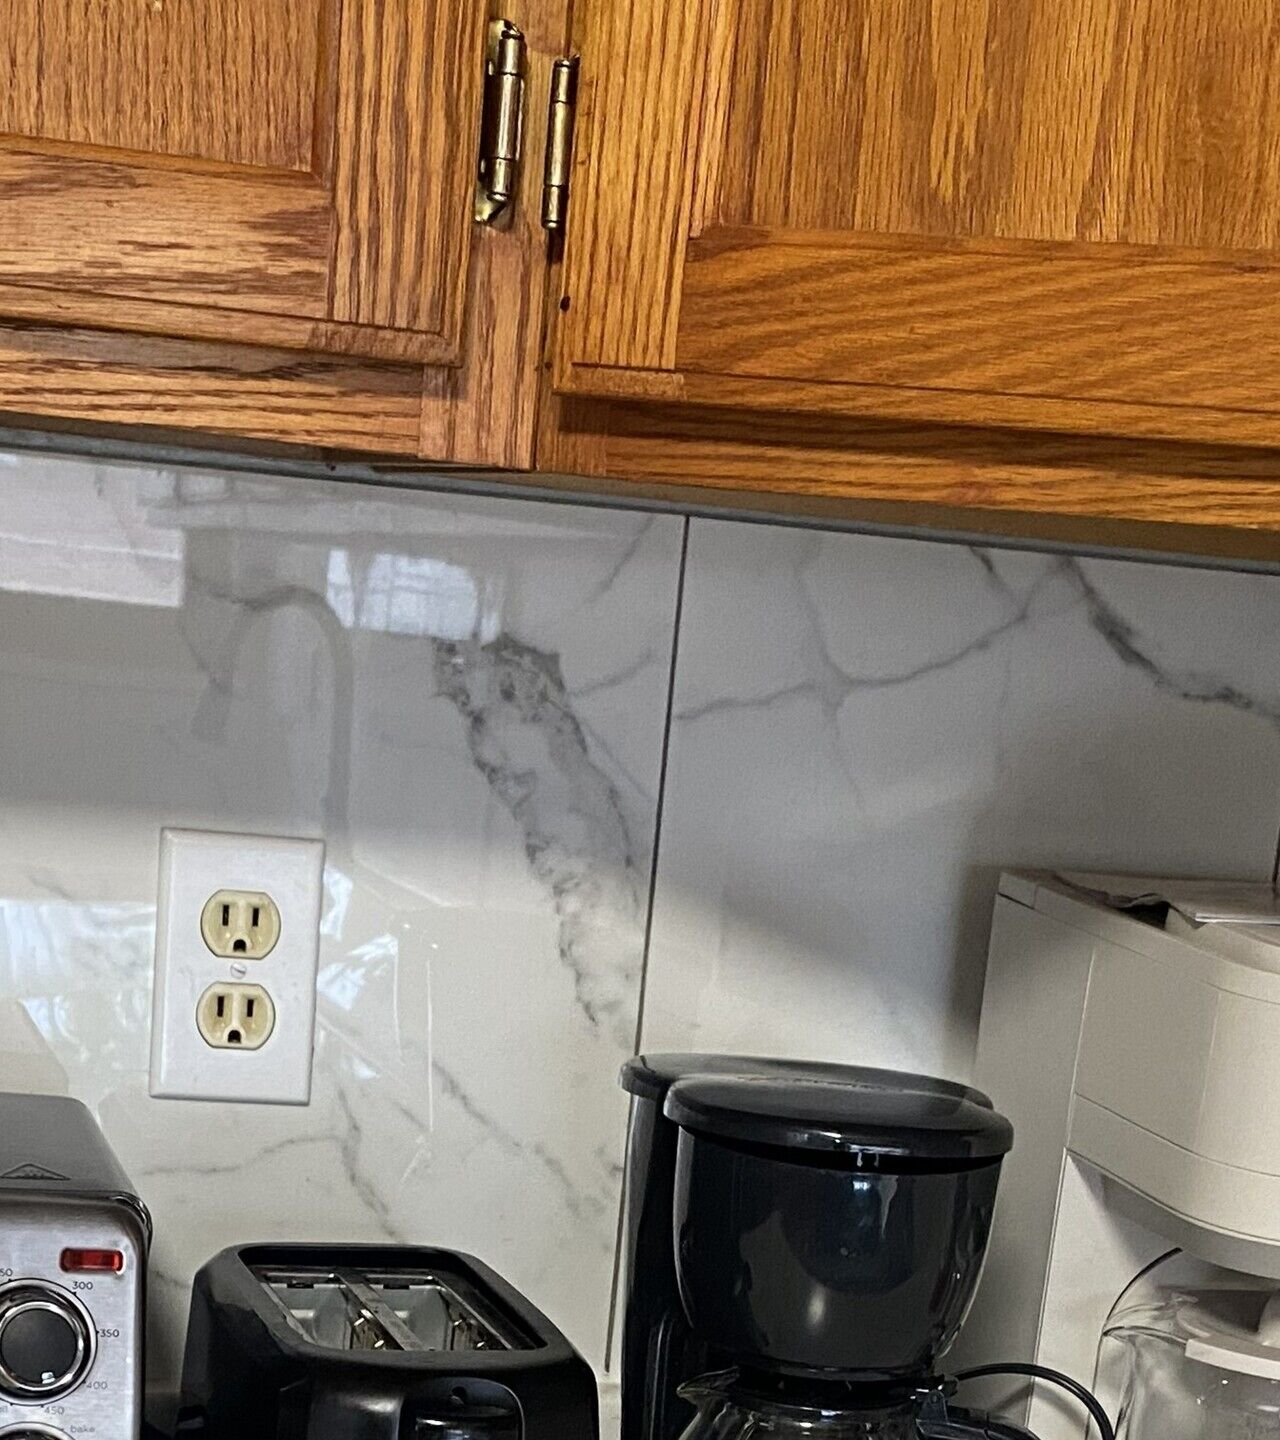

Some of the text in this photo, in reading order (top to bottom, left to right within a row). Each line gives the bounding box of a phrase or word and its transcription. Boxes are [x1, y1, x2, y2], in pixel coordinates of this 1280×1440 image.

[72, 1281, 94, 1290] 300
[99, 1329, 120, 1338] 350
[86, 1381, 108, 1390] 400
[44, 1406, 65, 1415] 450
[70, 1425, 96, 1433] bake
